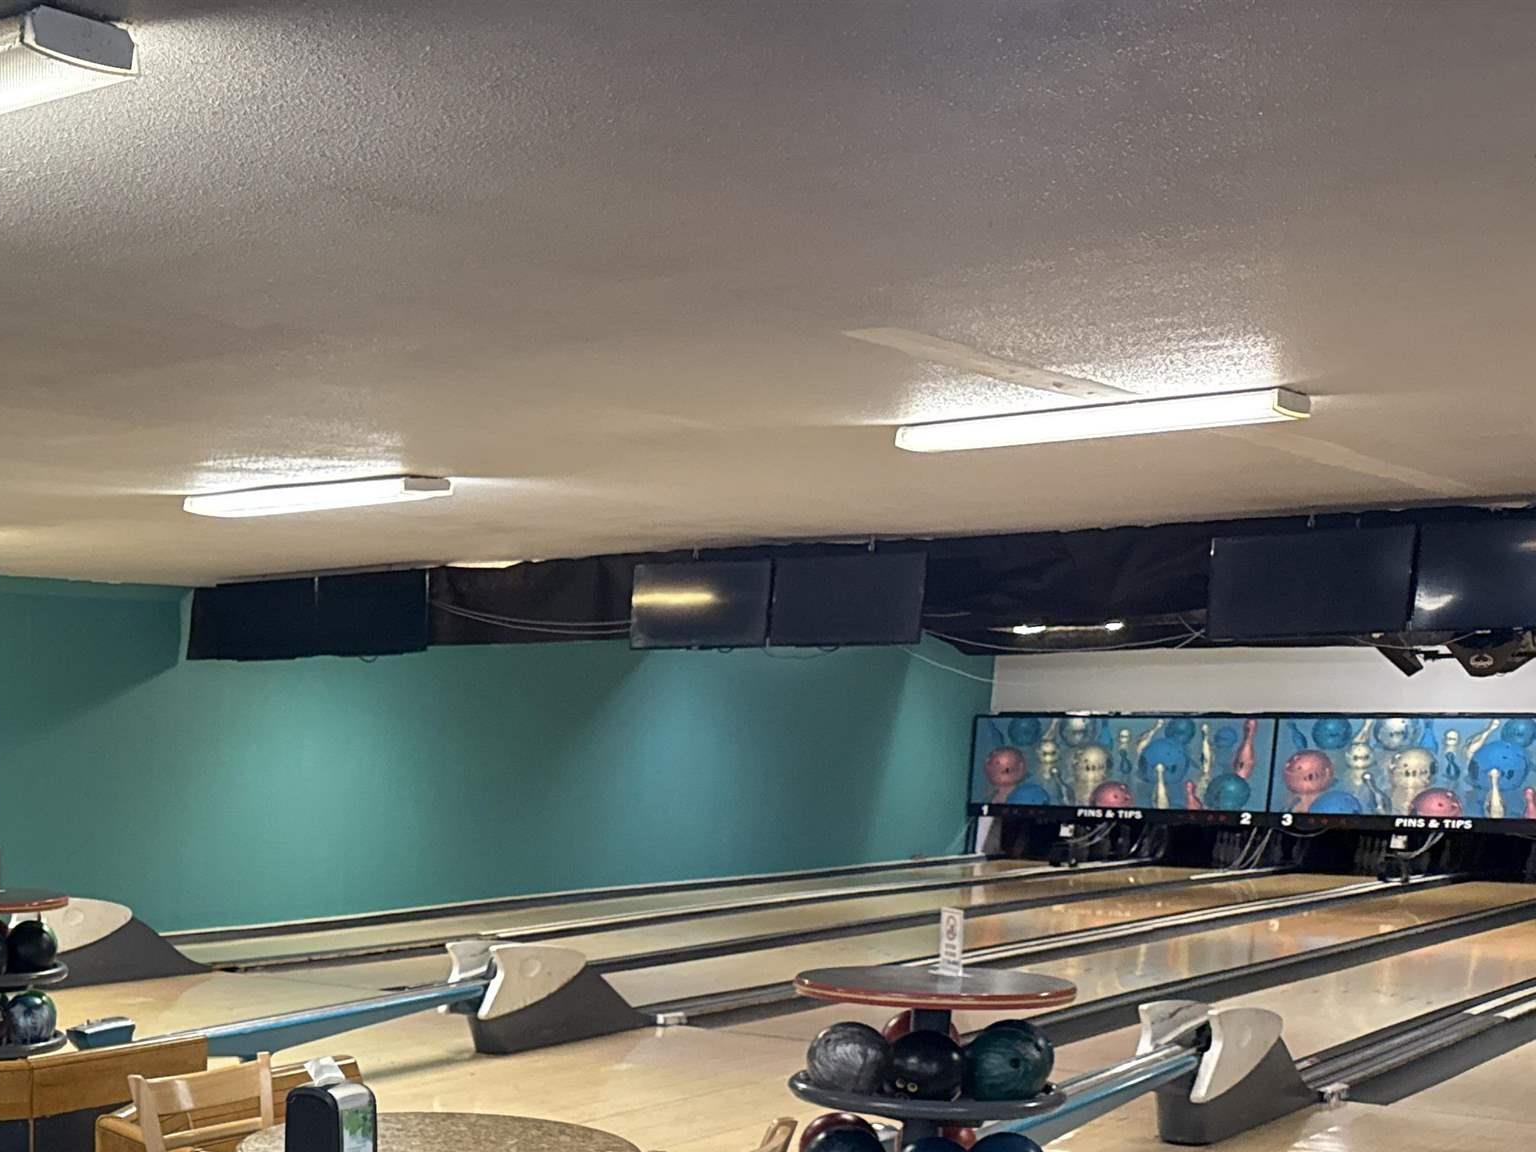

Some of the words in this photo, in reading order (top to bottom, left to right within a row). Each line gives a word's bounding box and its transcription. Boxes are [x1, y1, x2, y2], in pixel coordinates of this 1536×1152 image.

[981, 805, 989, 815] 1
[1077, 809, 1103, 818] PINS
[1105, 810, 1115, 818] &
[1118, 810, 1143, 819] TIPS
[1240, 812, 1252, 825] 2
[1281, 813, 1293, 827] 3
[1394, 818, 1425, 828] PINS
[1428, 819, 1440, 828] &
[1443, 819, 1473, 829] TIPS
